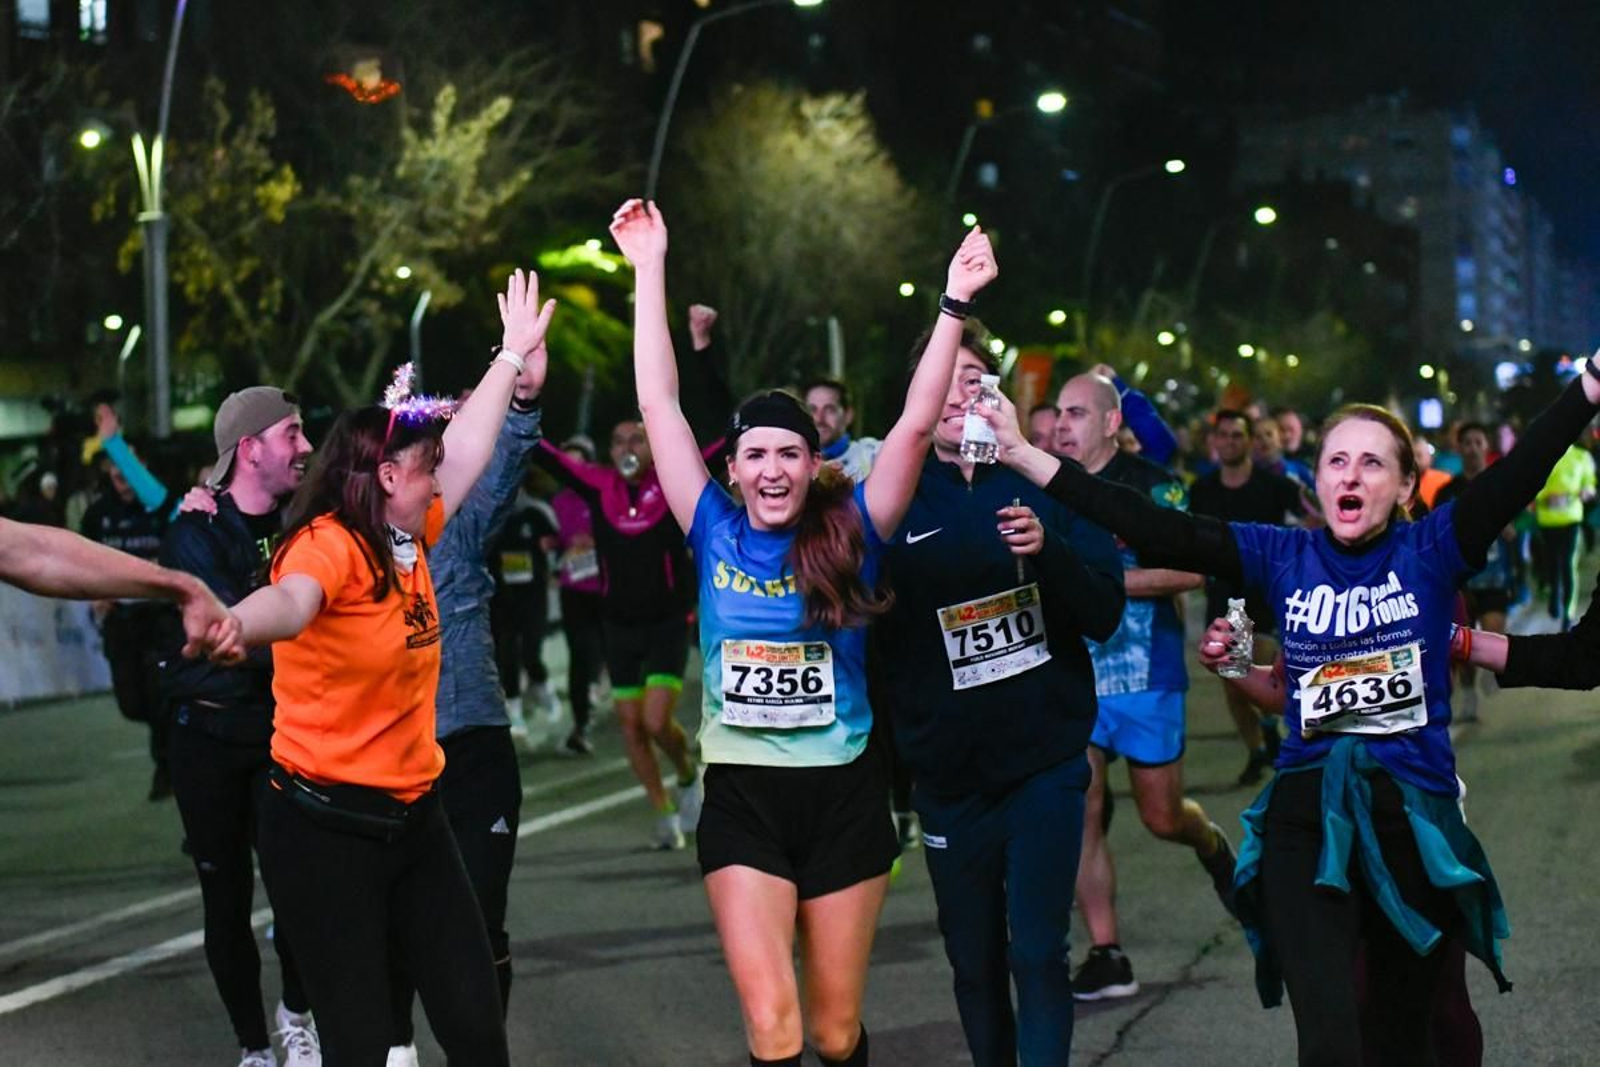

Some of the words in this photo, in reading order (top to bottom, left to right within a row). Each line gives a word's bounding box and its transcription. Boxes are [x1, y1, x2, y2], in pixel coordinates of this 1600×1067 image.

[1285, 584, 1370, 636] #016
[1371, 592, 1419, 626] TODAS
[951, 610, 1034, 657] 7510
[1329, 639, 1358, 650] todas
[1360, 636, 1374, 646] las
[1376, 628, 1413, 643] formas
[731, 665, 823, 696] 7356
[1312, 671, 1412, 713] 4636
